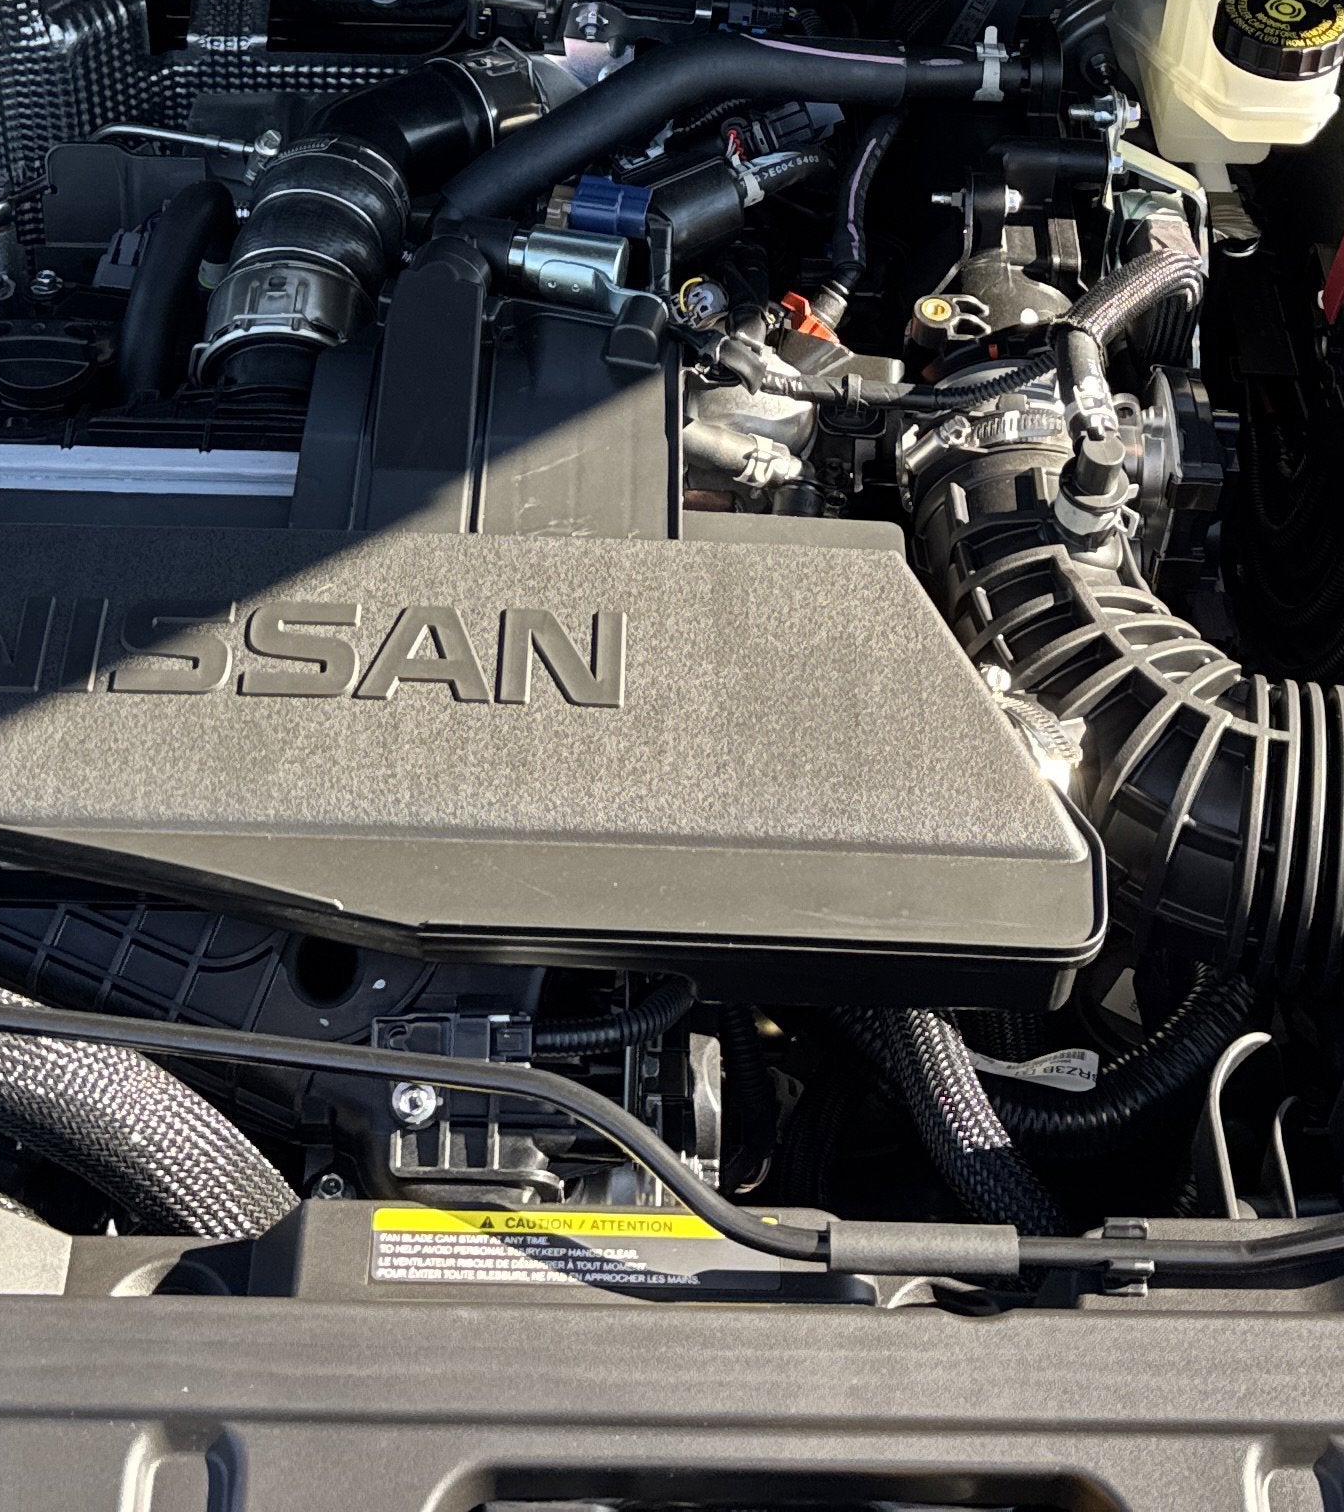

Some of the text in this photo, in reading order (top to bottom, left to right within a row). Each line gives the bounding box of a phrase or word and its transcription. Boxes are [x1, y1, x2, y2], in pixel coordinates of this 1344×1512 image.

[1281, 38, 1306, 47] FROM
[505, 1217, 573, 1231] CAUTION
[590, 1219, 674, 1233] ATTENTION
[379, 1233, 401, 1243] FAN
[402, 1233, 434, 1244] BLADE
[435, 1233, 457, 1244] CAN
[458, 1234, 490, 1244] START
[503, 1236, 525, 1245] ANY
[379, 1244, 394, 1254] TO
[395, 1245, 421, 1255] HELP
[422, 1245, 453, 1255] AVOID
[453, 1246, 507, 1256] PERSONAL
[568, 1248, 603, 1258] HANDS
[377, 1256, 391, 1267] LE
[392, 1256, 455, 1268] VENTILATEUR
[456, 1258, 495, 1269] RISQUE
[496, 1258, 510, 1269] DE
[567, 1258, 575, 1270] À
[576, 1260, 602, 1270] TOUT
[376, 1267, 408, 1279] POUR
[408, 1266, 442, 1279] ÉVITER
[443, 1269, 475, 1280] TOUTE
[531, 1271, 546, 1282] NE
[547, 1271, 568, 1282] PAS
[584, 1273, 646, 1284] APPROCHER
[647, 1274, 666, 1284] LES
